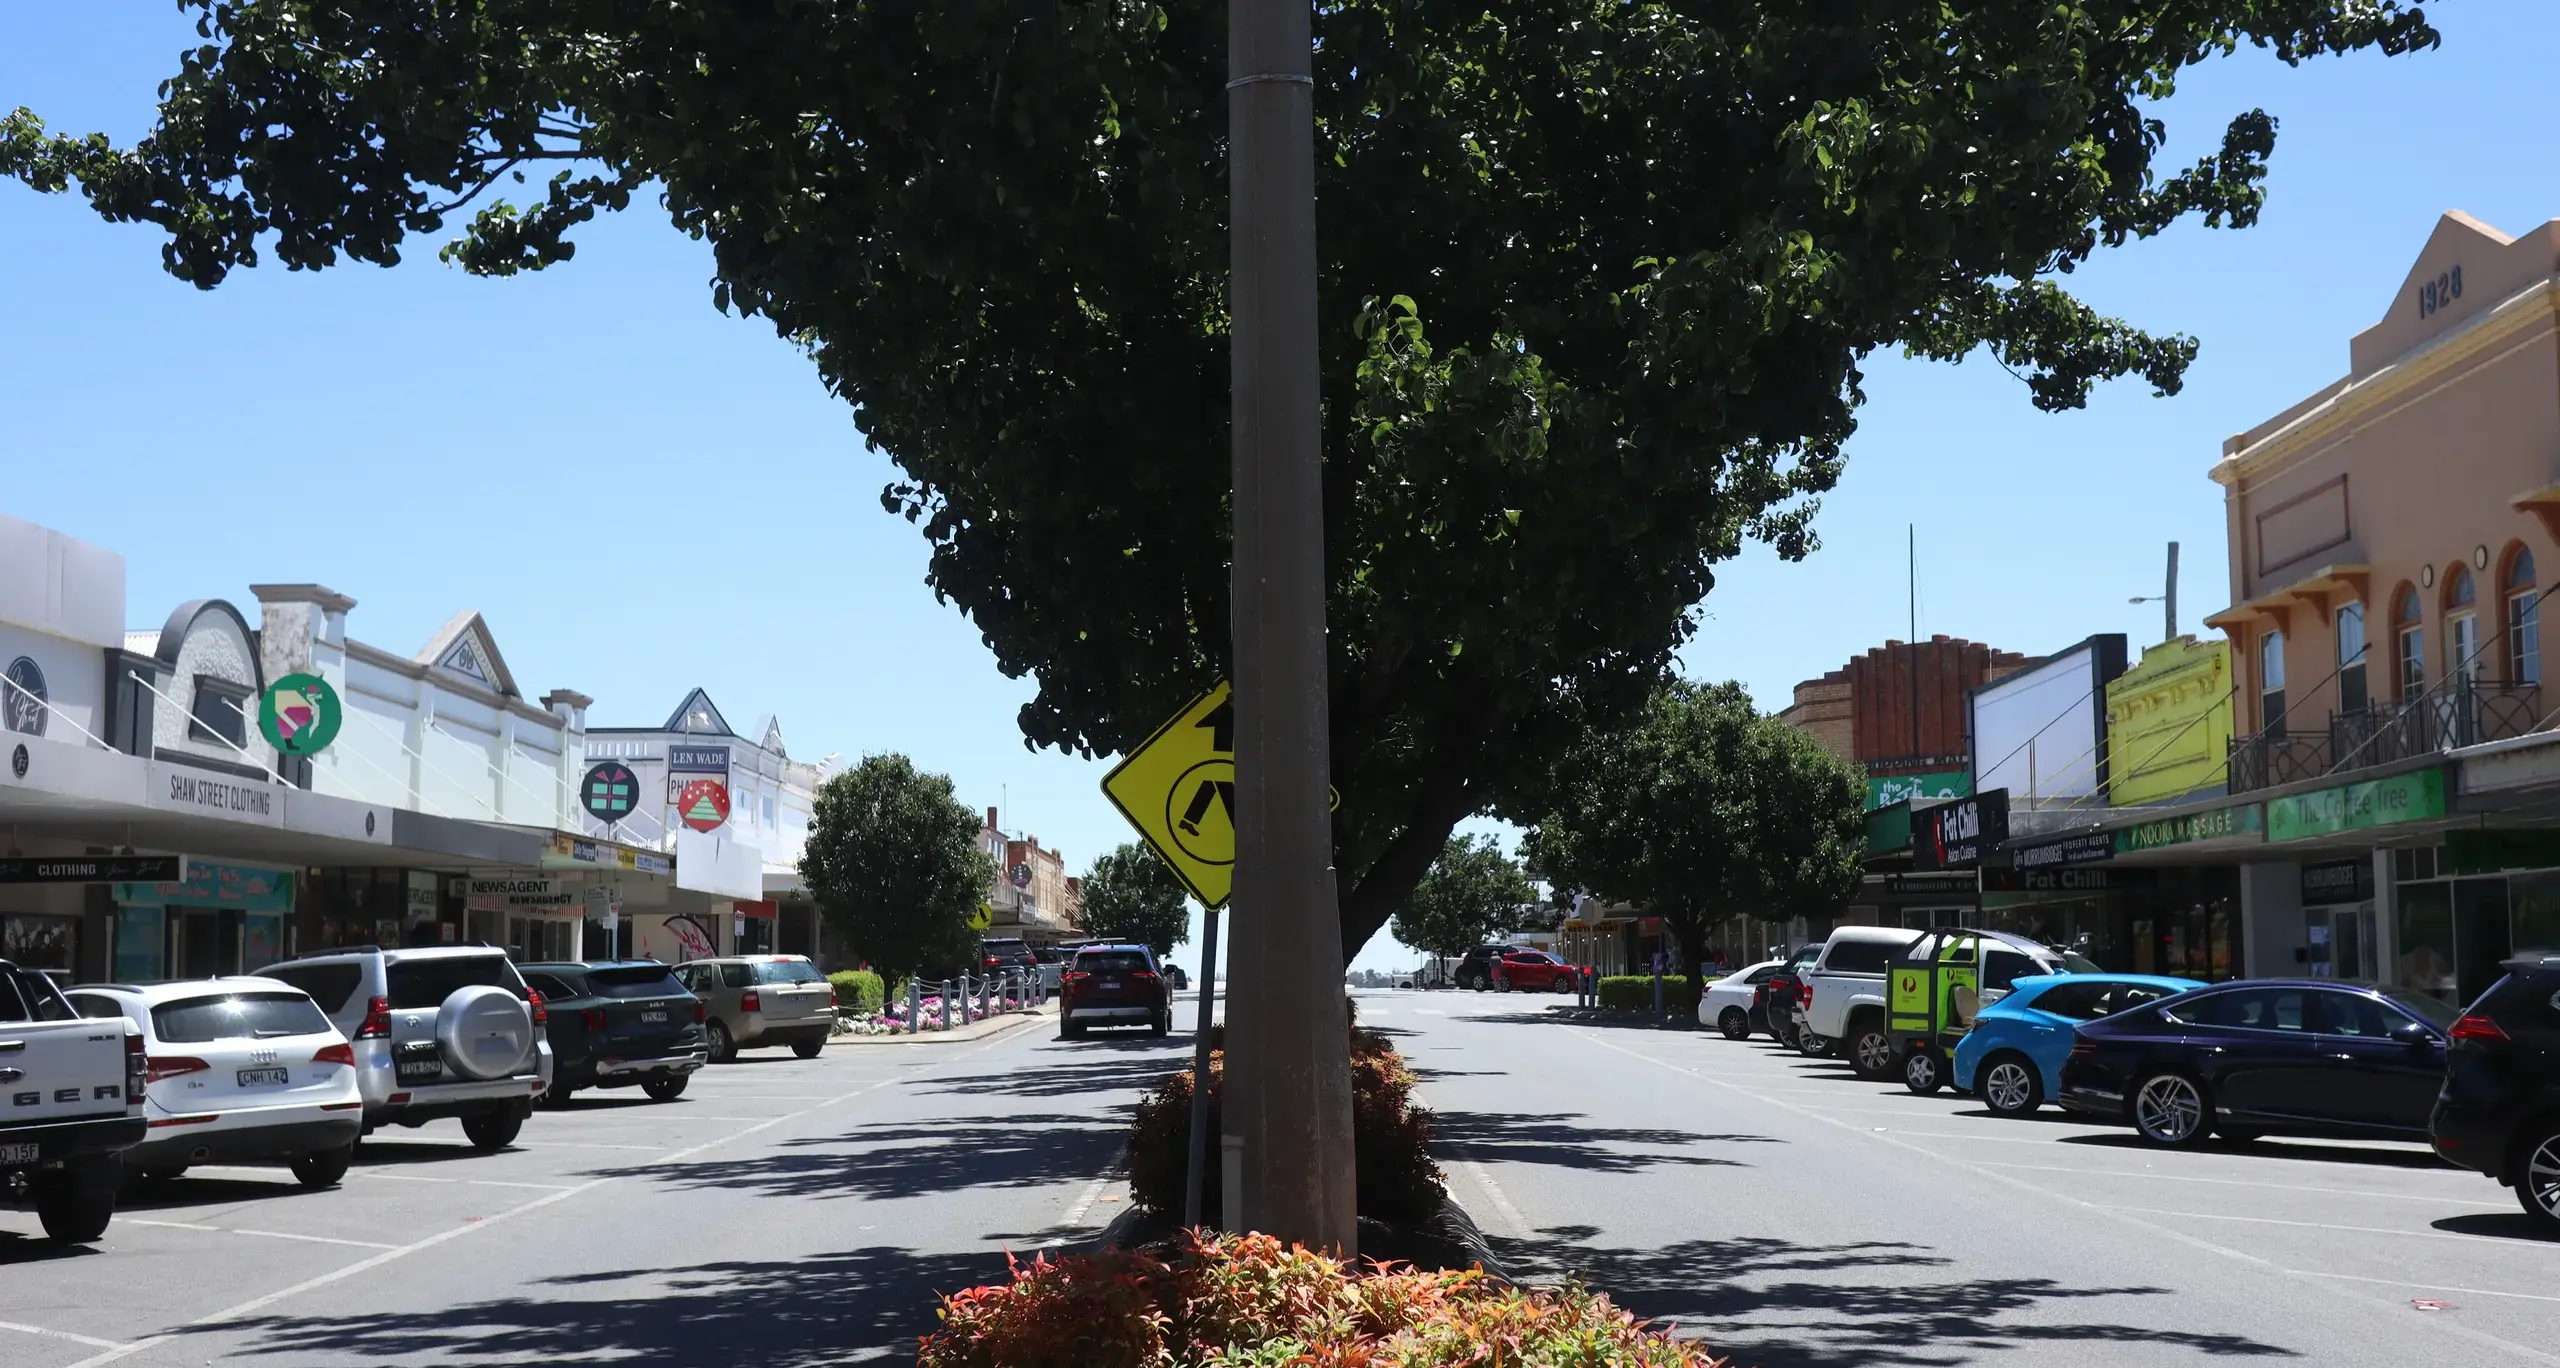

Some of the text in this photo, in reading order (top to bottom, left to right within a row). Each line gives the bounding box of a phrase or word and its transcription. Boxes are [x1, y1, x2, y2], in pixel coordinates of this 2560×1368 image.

[2420, 264, 2462, 320] 1928
[672, 752, 725, 765] LEN WADE
[170, 774, 270, 816] SHAW STREET CLOTHING
[1883, 780, 1902, 793] the
[2296, 782, 2408, 827] The Coffee Tree
[1943, 801, 1979, 843] Fat Chilli
[2139, 814, 2232, 846] NOORA MASSAGE
[2062, 833, 2110, 850] PROPERTY AGENTS
[1947, 845, 1977, 863] Asian Cuisine
[38, 863, 96, 876] CLOTHING
[471, 880, 550, 894] NEWSAGENT
[2025, 869, 2056, 889] Fat
[509, 893, 573, 906] NEWSAGENCY
[242, 1072, 264, 1085] CNH
